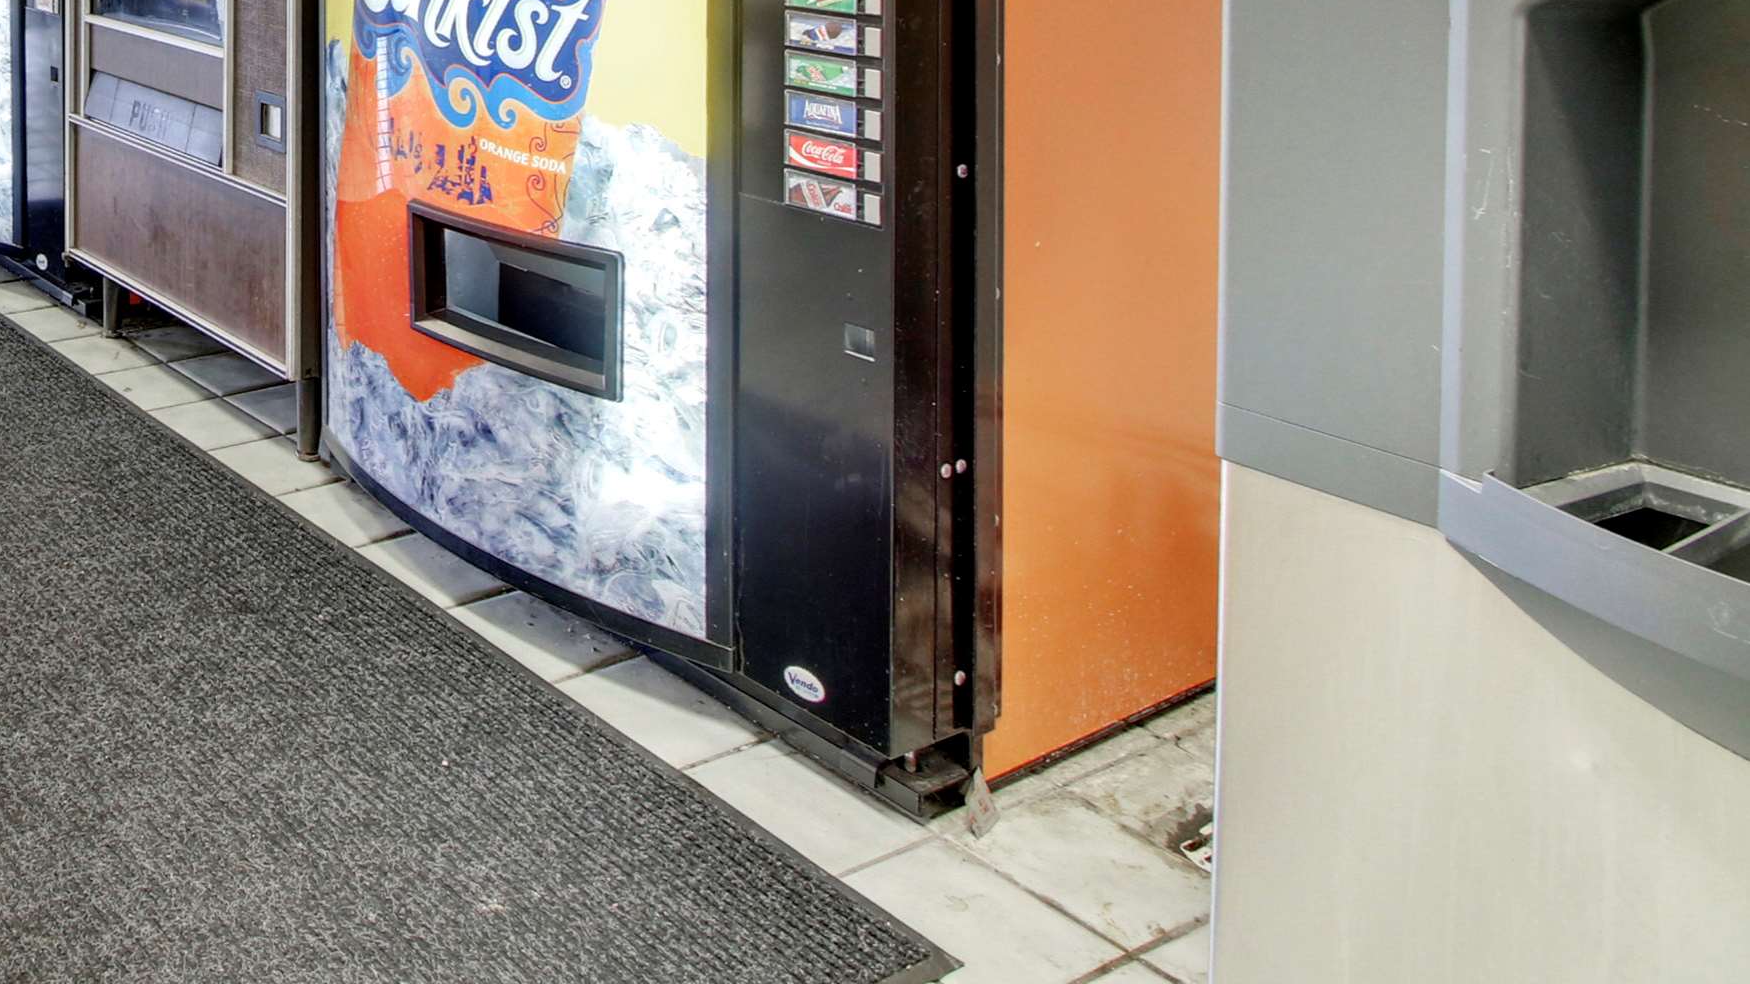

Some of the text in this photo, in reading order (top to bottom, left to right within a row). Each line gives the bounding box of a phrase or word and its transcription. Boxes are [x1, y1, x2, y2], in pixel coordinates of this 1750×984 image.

[129, 100, 170, 138] PUSH
[803, 98, 843, 125] AQUAFINA
[479, 138, 567, 175] ORANGE SODA
[787, 671, 820, 694] Vendo
